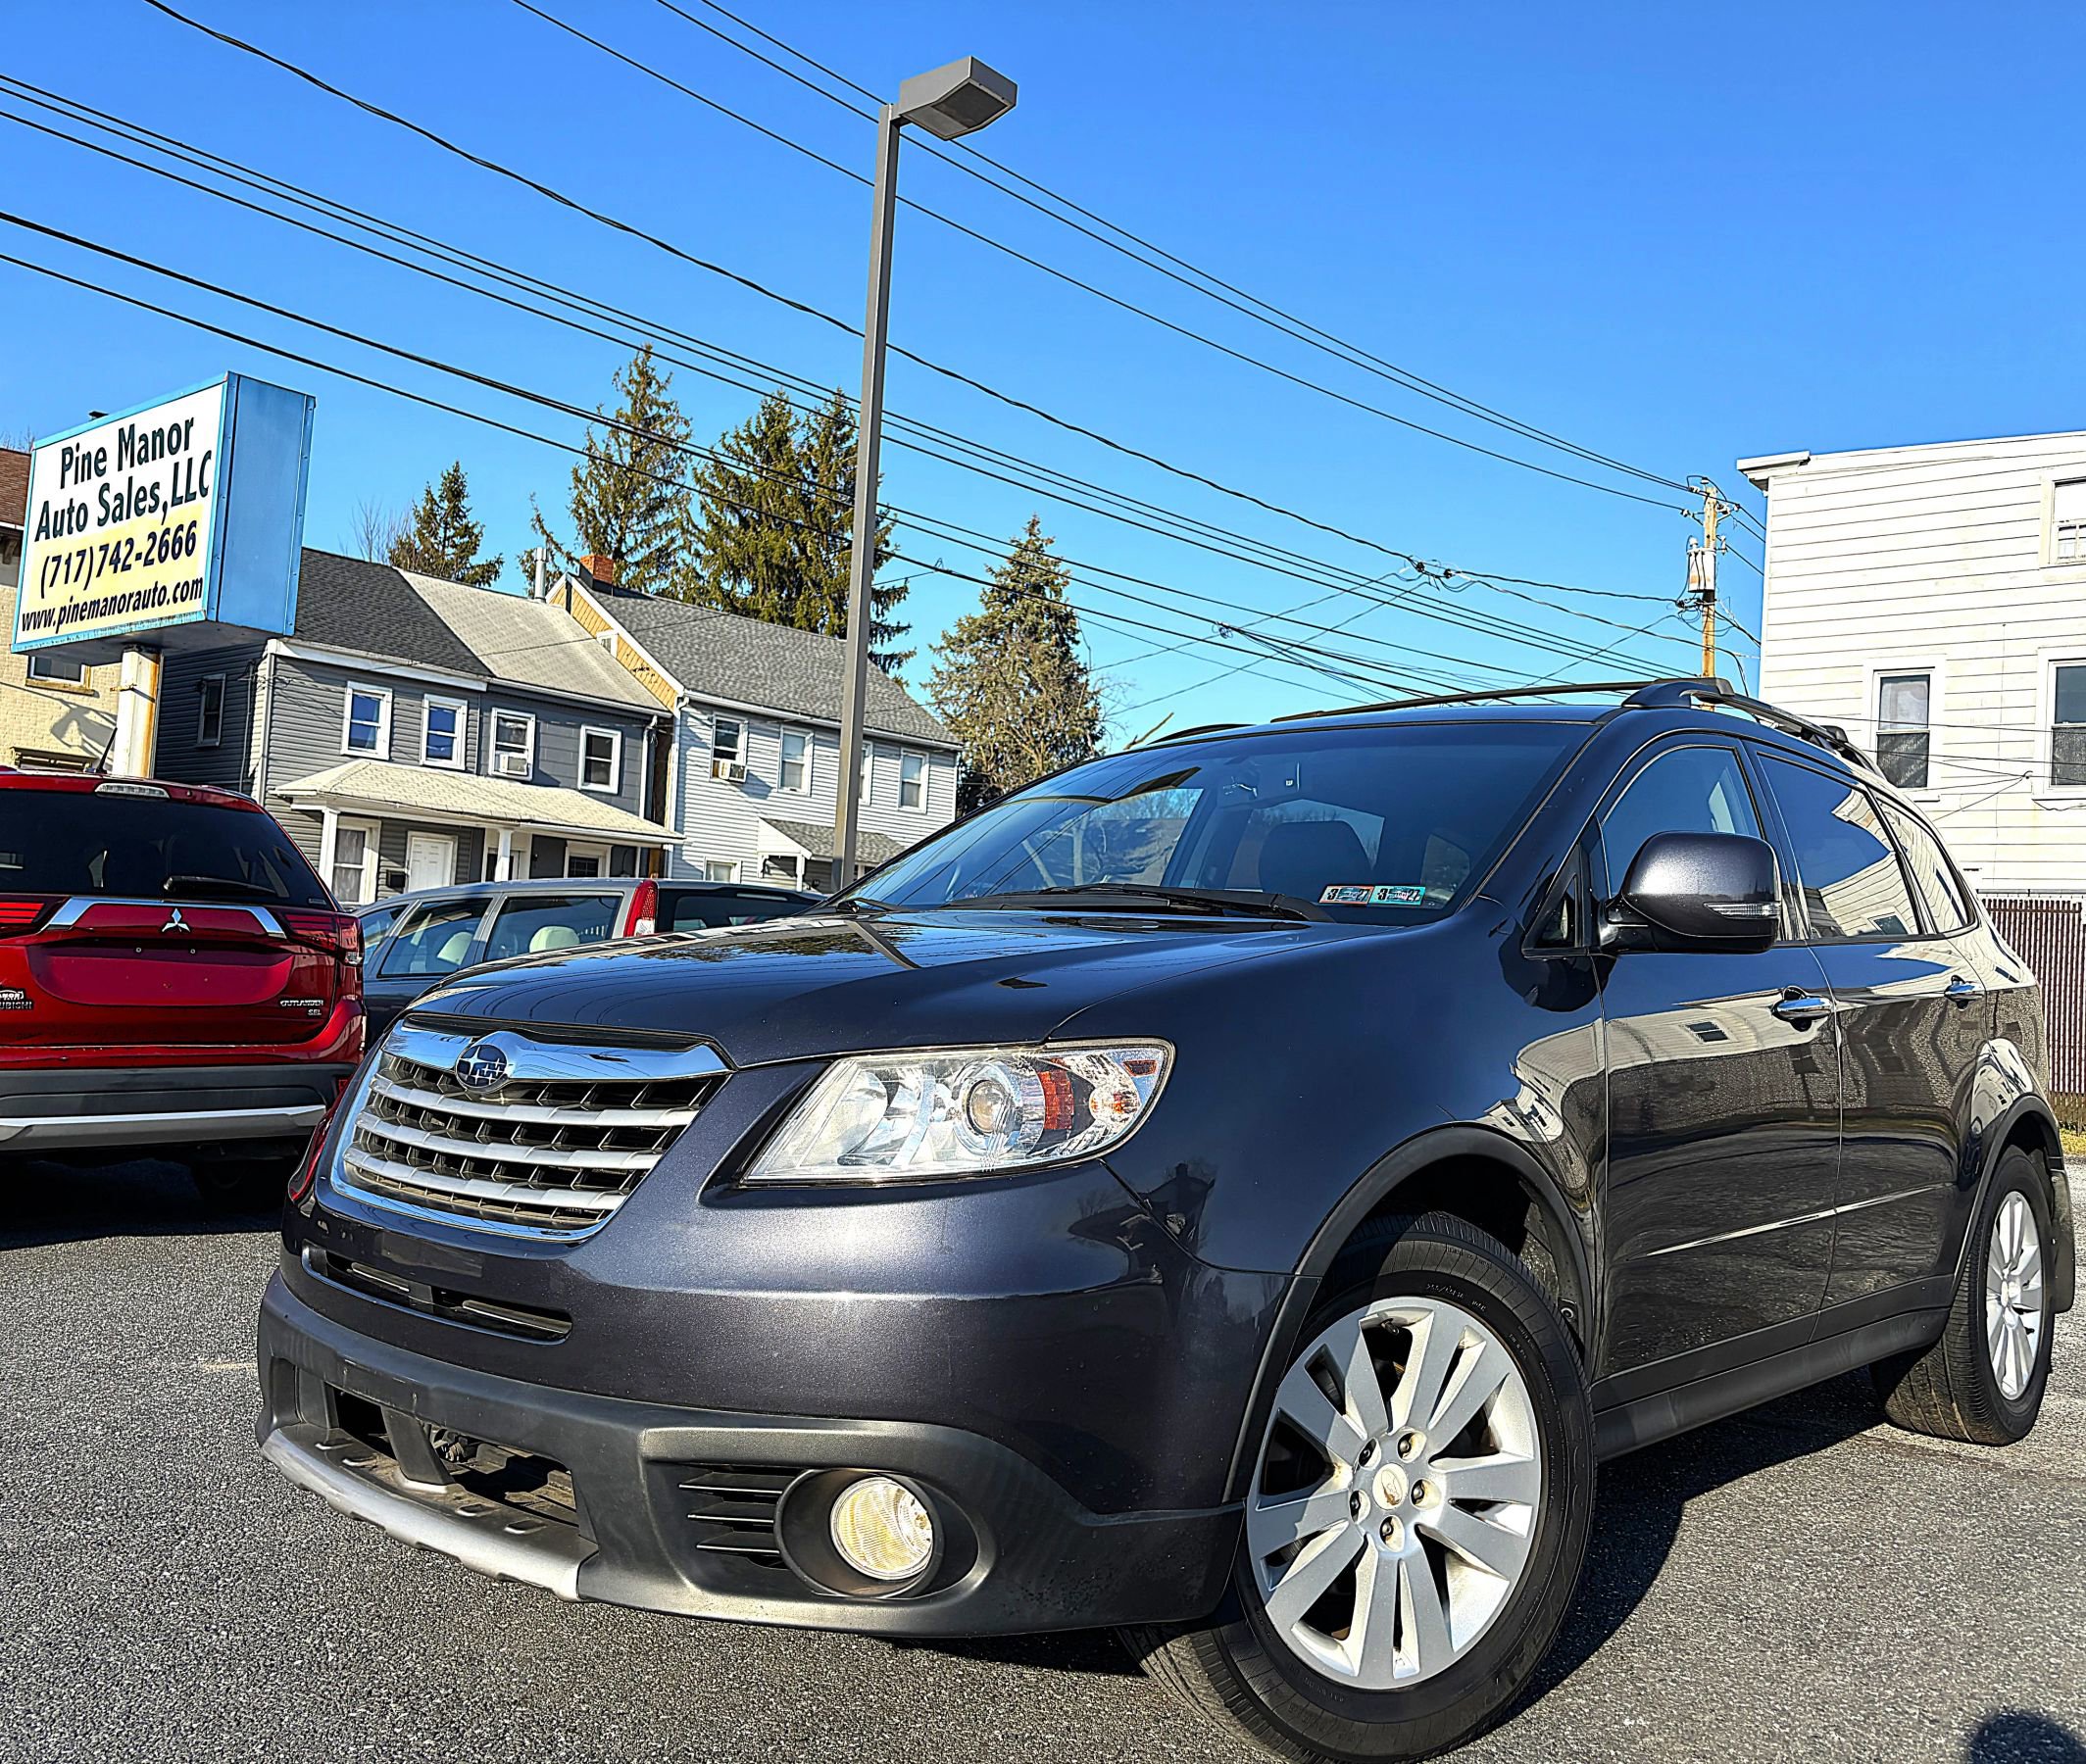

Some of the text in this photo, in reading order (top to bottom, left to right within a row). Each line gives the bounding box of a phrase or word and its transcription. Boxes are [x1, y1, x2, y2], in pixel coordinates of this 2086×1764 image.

[60, 416, 194, 489] Pine Manor
[34, 498, 89, 542] Auto
[40, 520, 197, 599] (717)742-2666
[22, 576, 204, 634] www.pinemanorauto.com
